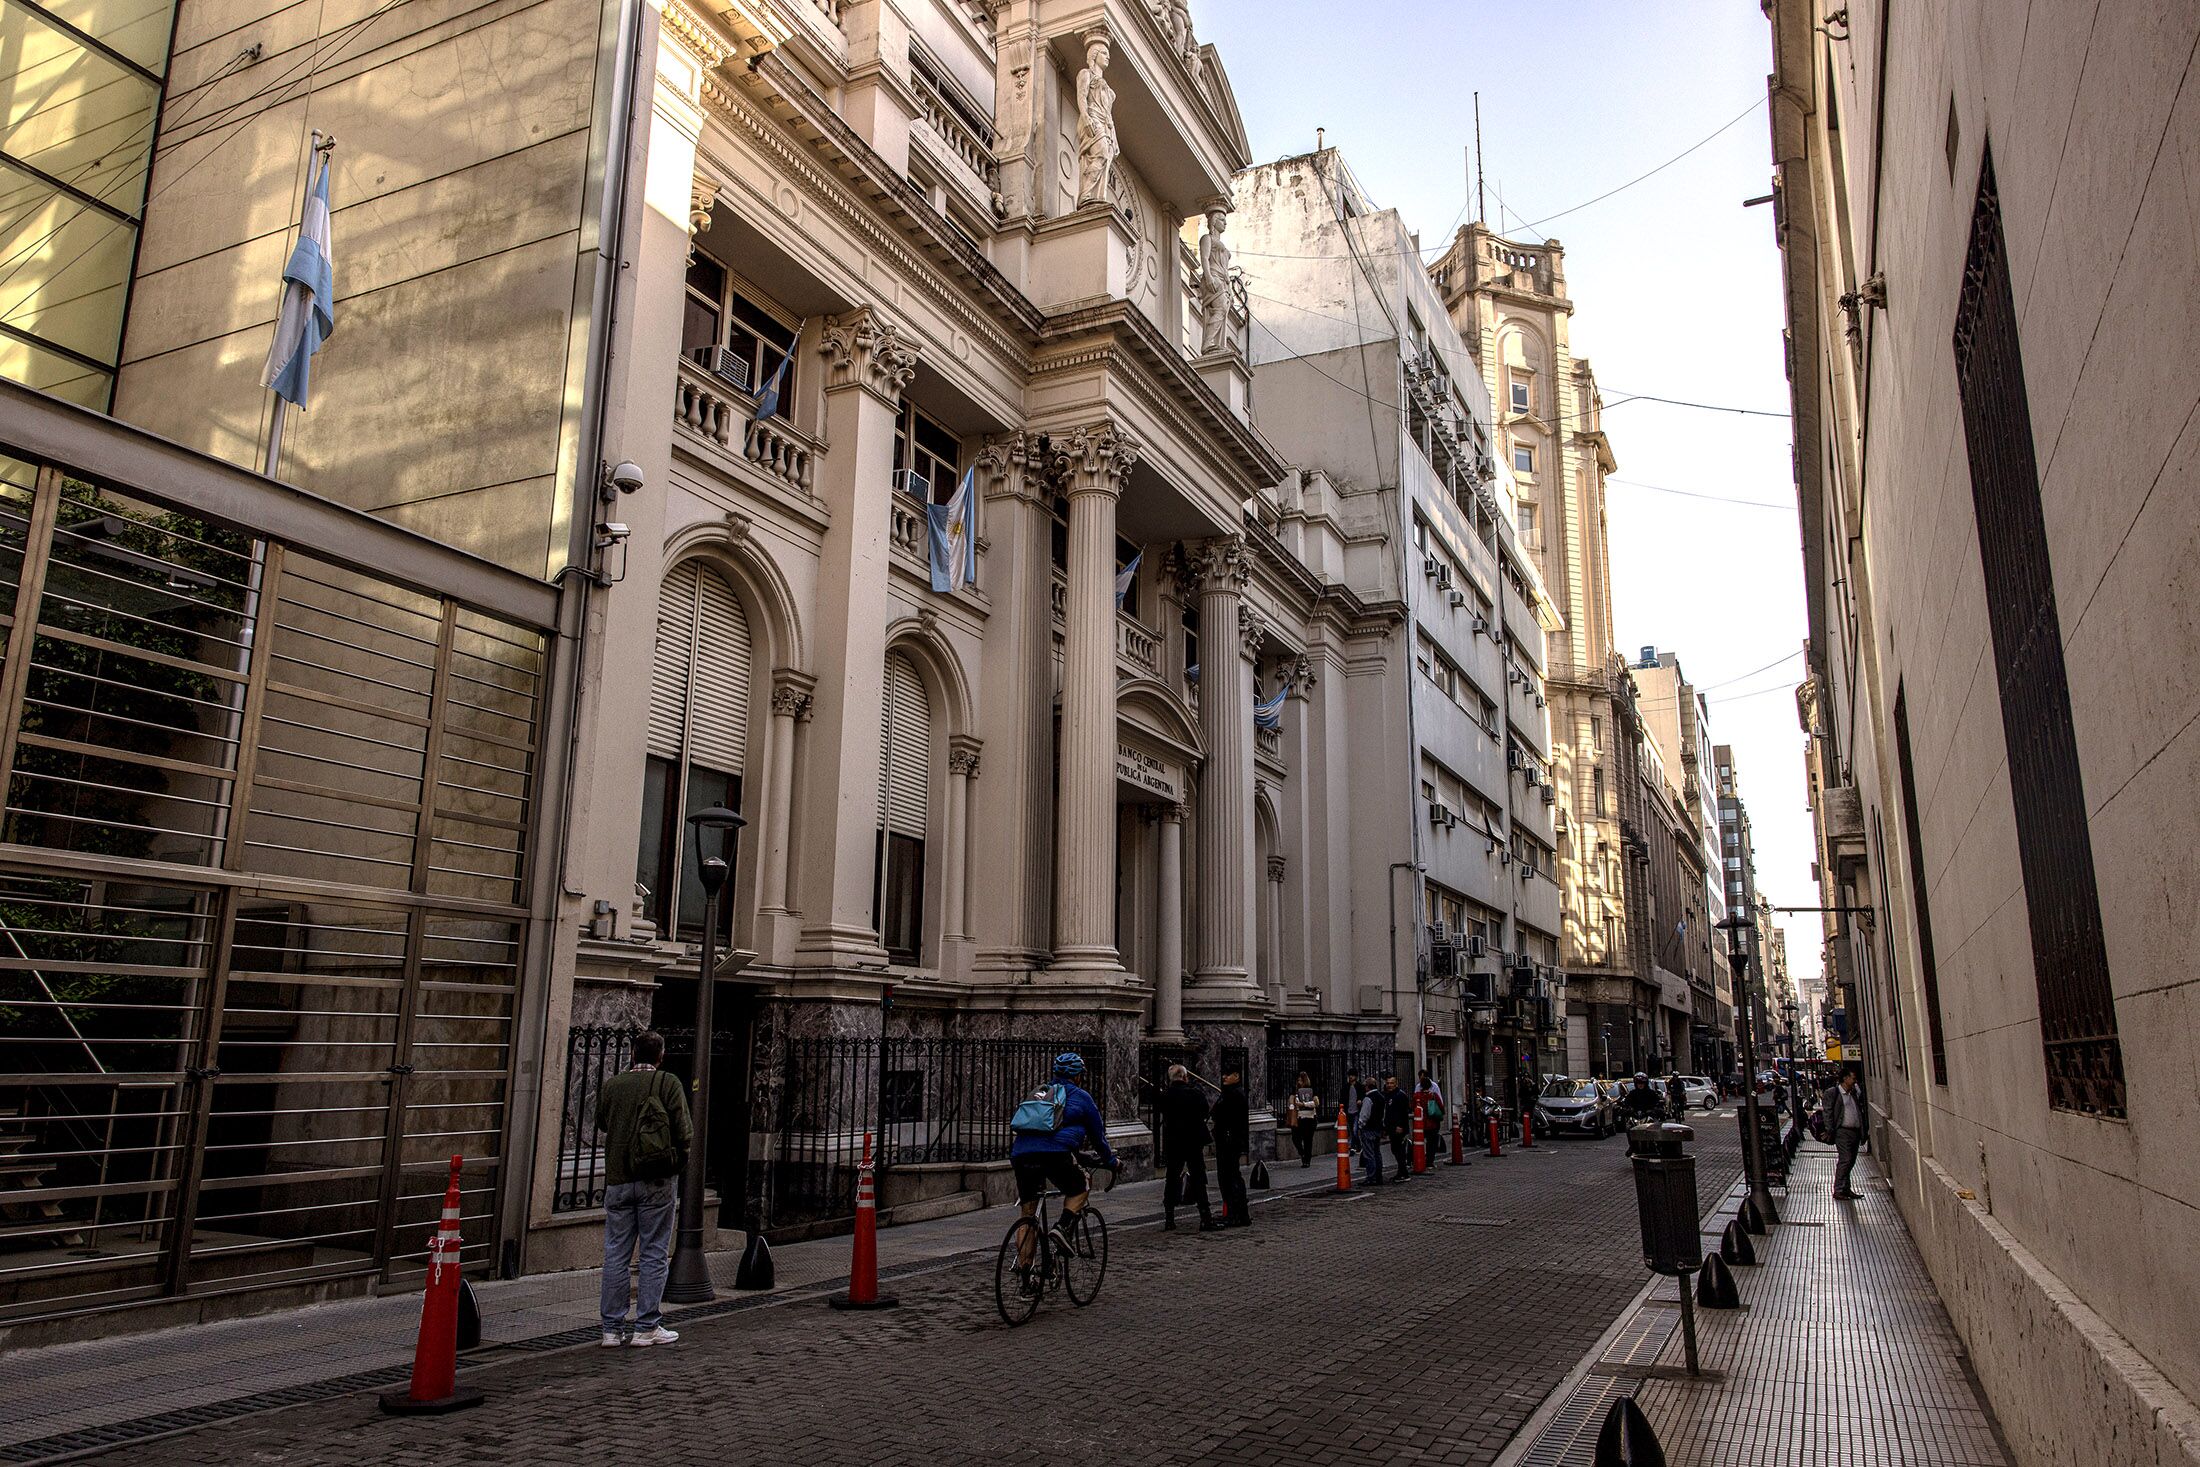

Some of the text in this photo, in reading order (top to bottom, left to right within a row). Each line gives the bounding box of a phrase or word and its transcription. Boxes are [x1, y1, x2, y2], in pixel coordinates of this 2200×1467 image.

[1118, 744, 1165, 774] BANCO CENTRAL
[1143, 774, 1173, 795] ARGENTINA
